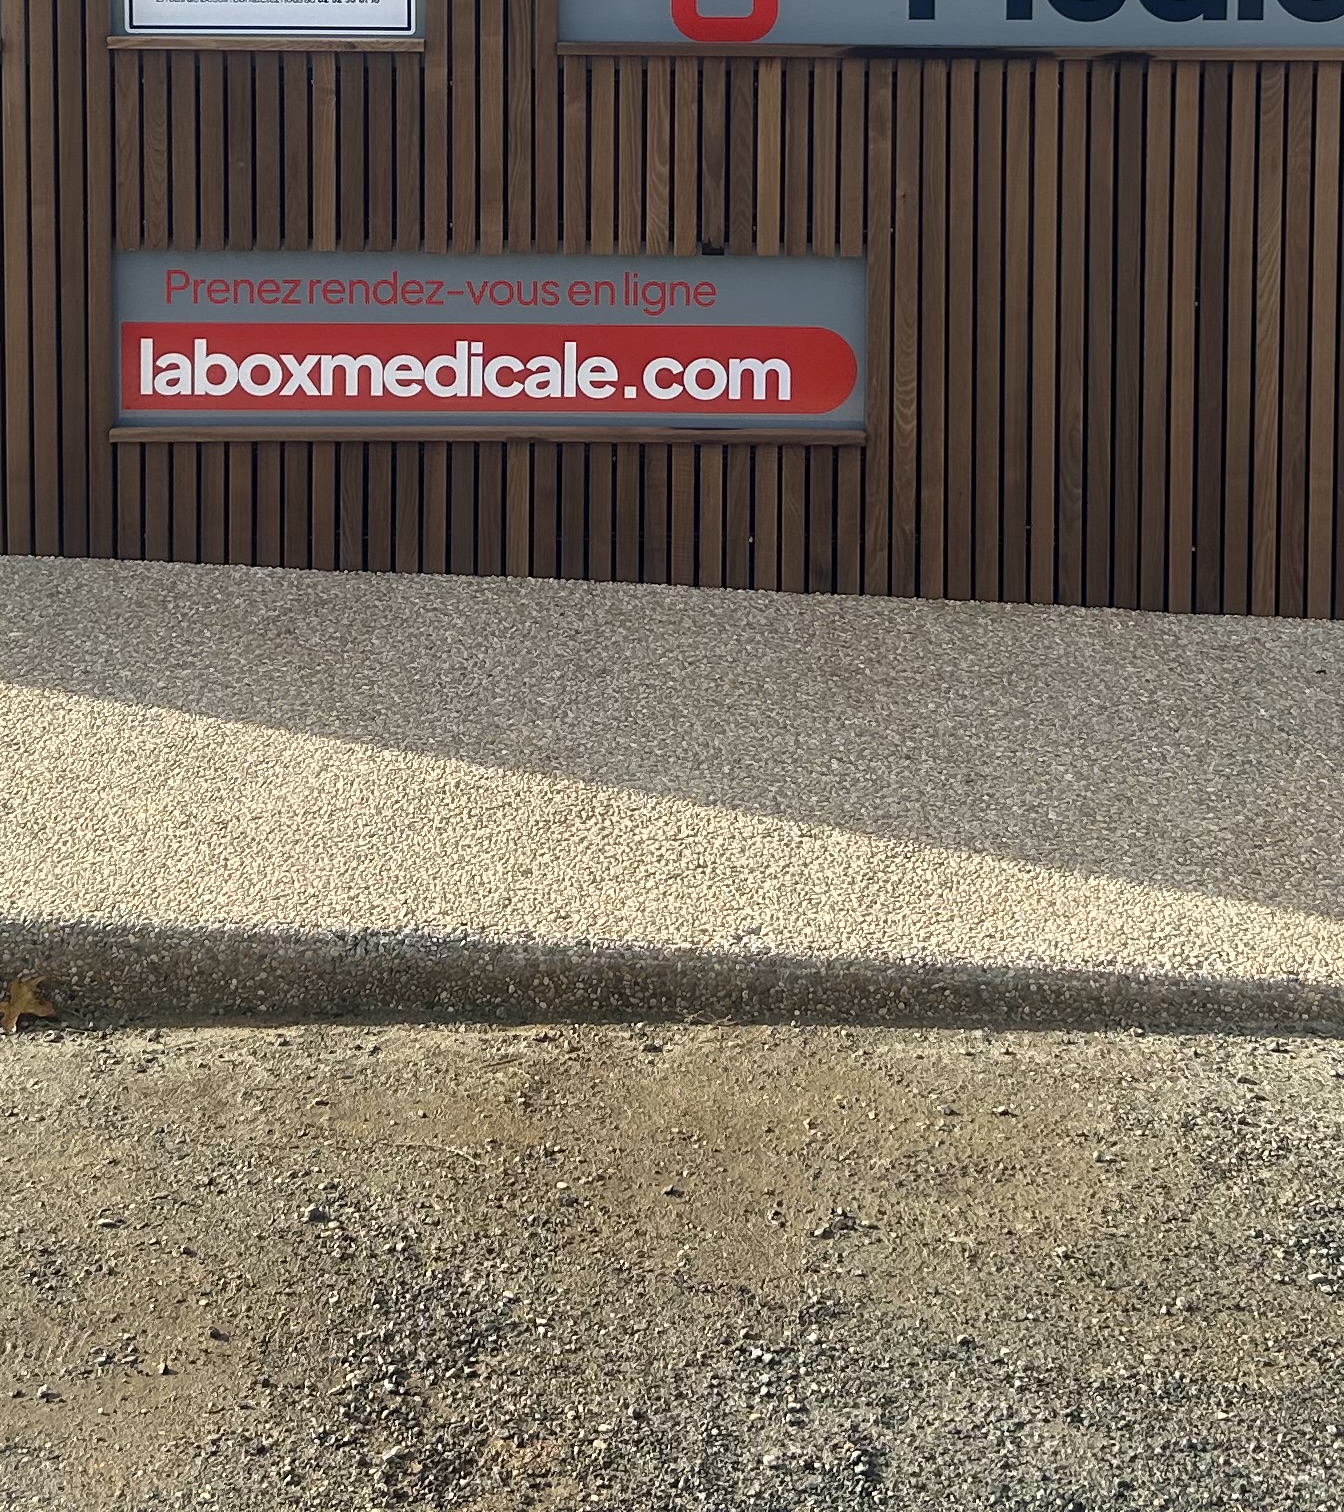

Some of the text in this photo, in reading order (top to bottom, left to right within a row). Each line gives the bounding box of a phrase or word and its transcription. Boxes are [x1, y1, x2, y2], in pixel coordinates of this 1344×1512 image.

[165, 269, 717, 318] Prenez rendez-vous en ligne
[140, 337, 792, 401] laboxmedicale.com
